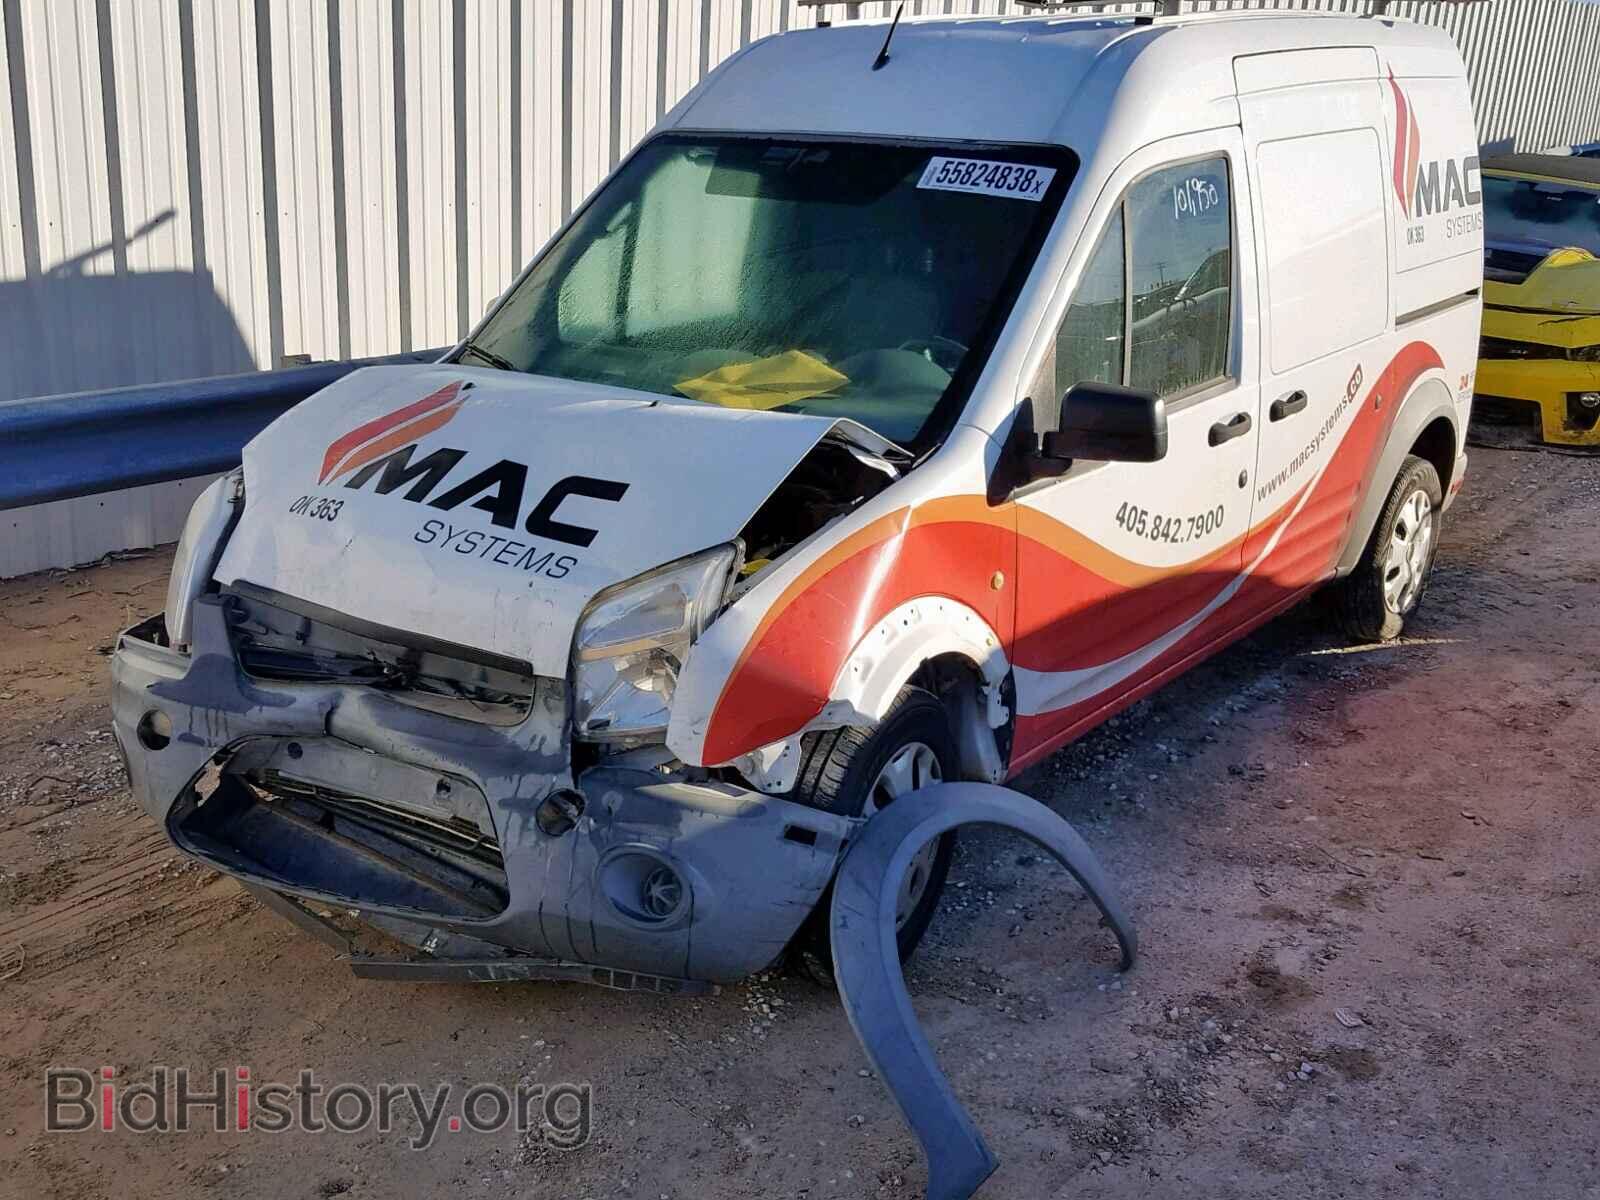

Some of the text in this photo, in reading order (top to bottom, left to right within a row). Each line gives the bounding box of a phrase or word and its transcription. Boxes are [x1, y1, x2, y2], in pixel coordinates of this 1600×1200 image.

[1415, 155, 1481, 218] MAC
[1446, 211, 1482, 239] SYSTEMS
[288, 495, 344, 522] OK 363
[344, 443, 631, 548] MAC
[1115, 501, 1225, 544] 405.842.7900
[414, 519, 578, 579] SYSTEMS
